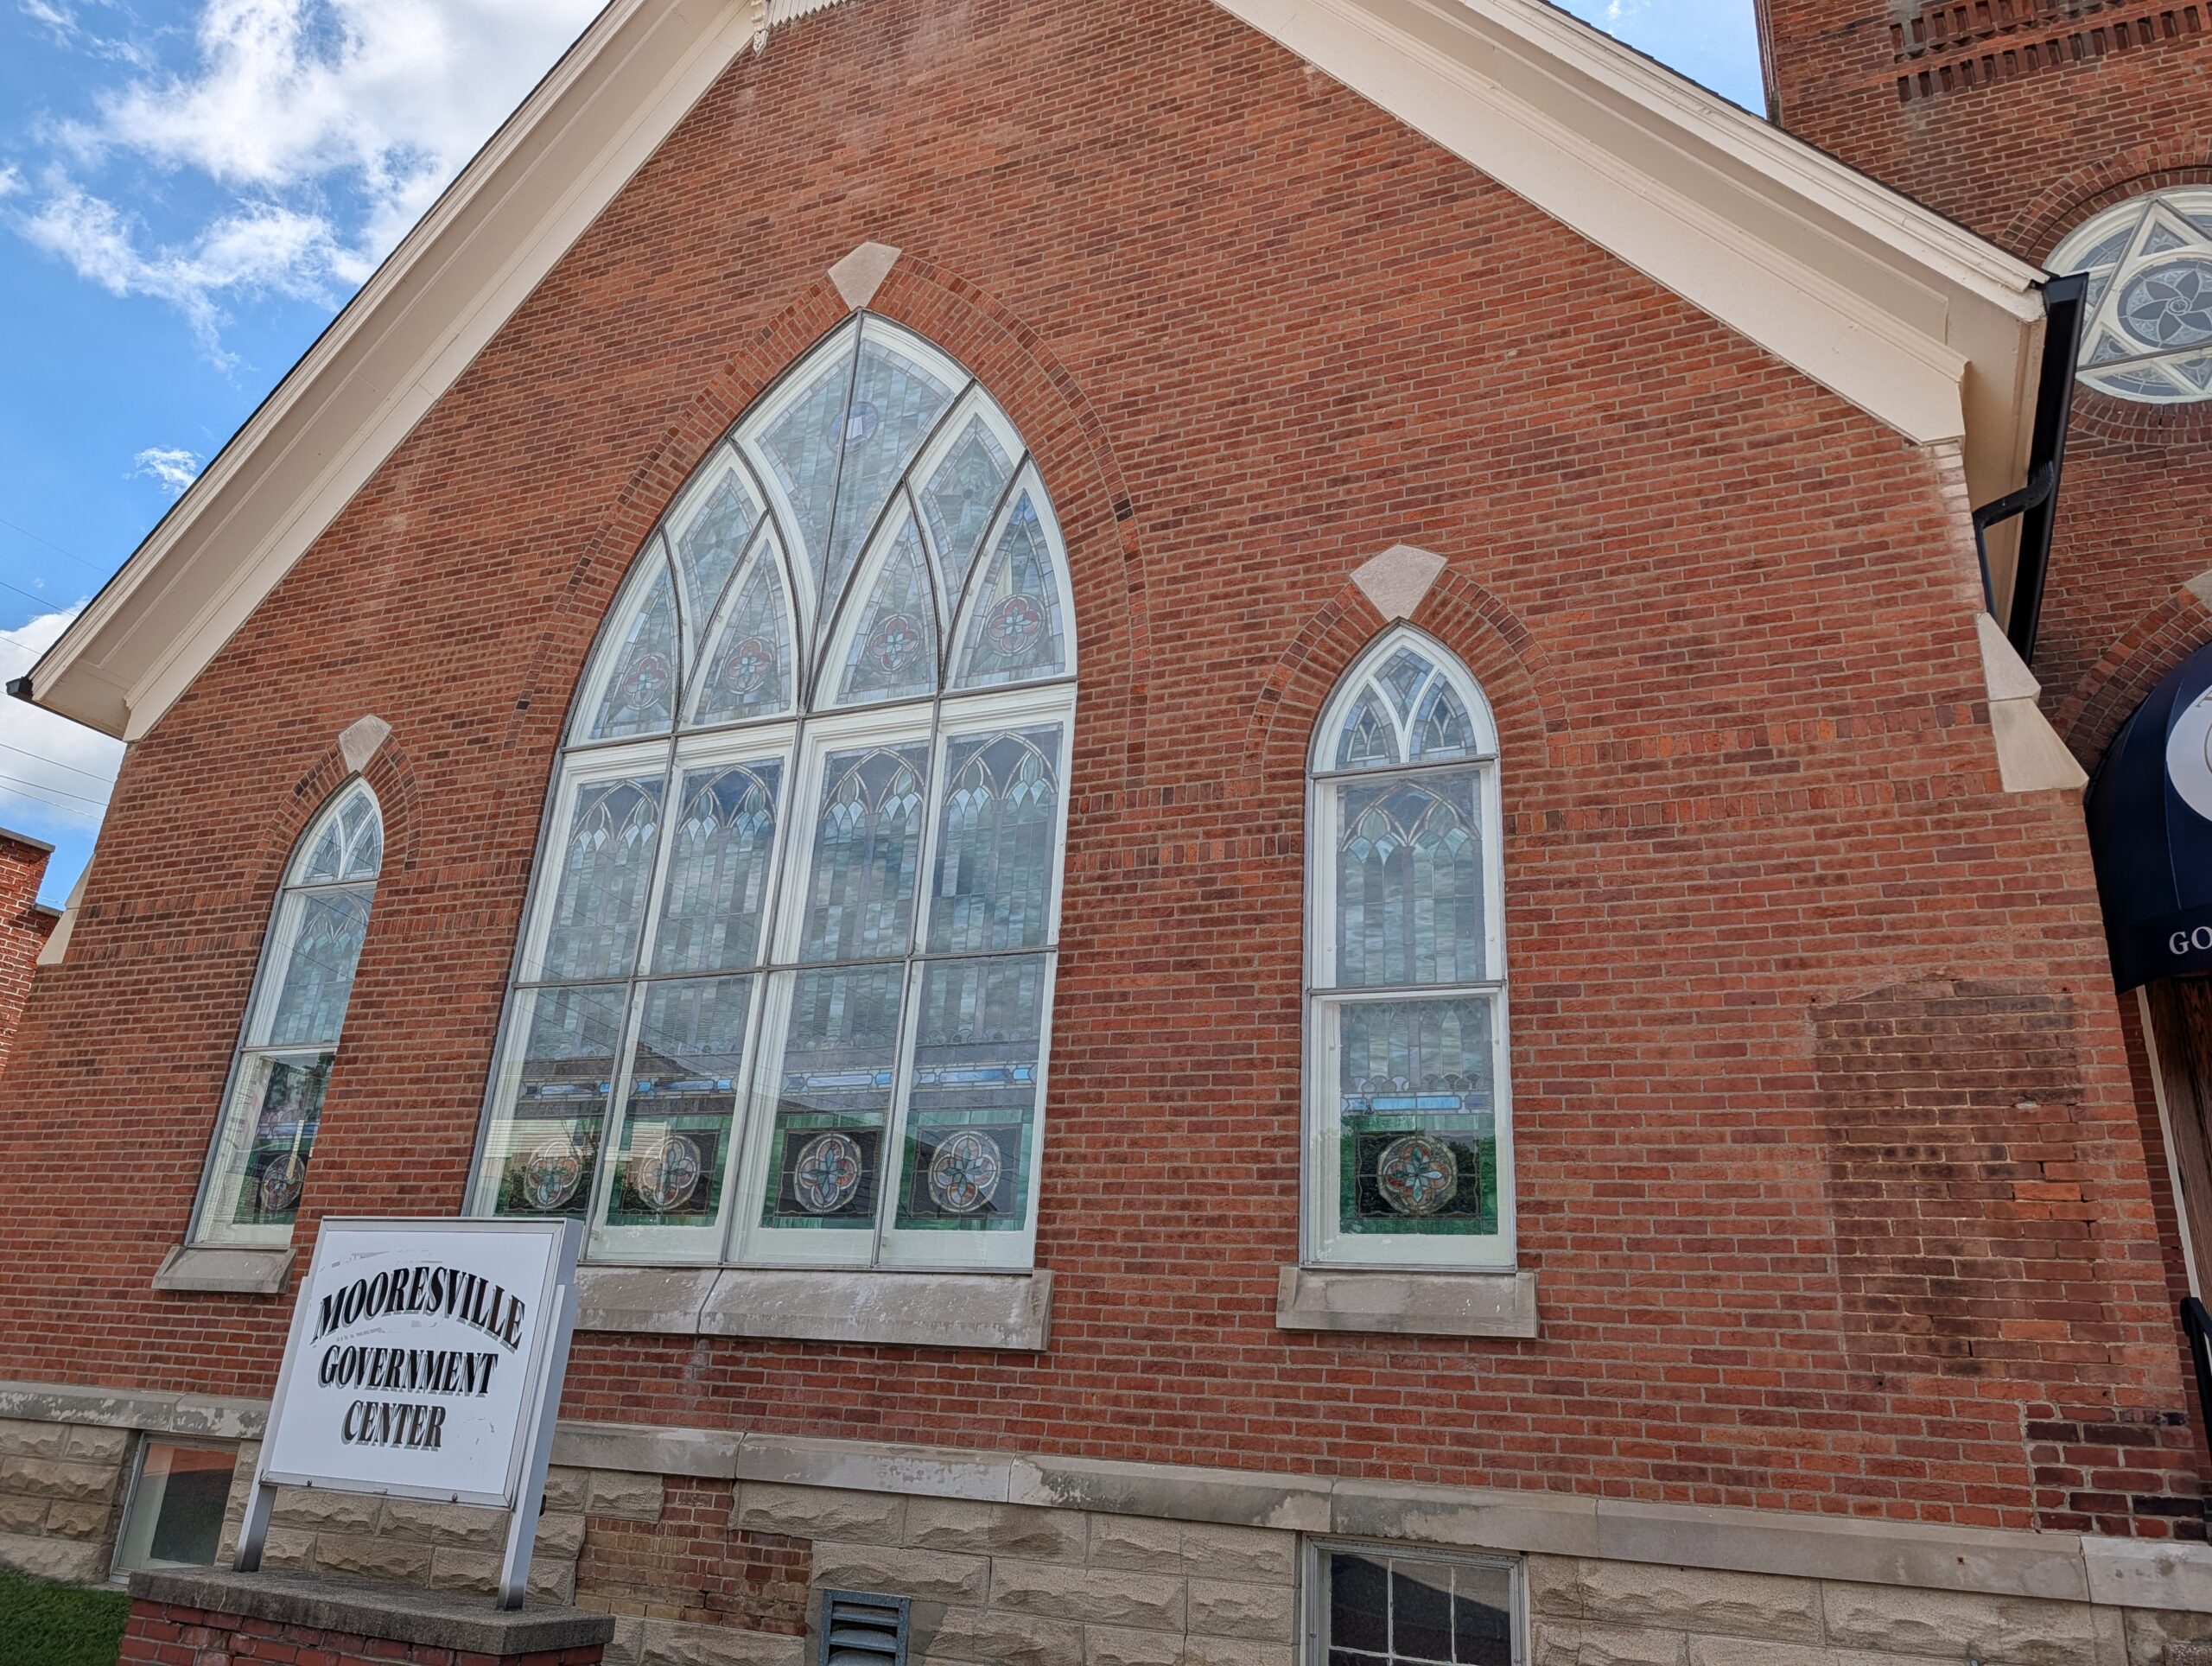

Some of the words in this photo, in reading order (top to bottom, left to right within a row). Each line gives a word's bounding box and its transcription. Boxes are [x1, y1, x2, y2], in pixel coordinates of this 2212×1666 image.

[2169, 925, 2212, 955] GO
[310, 1266, 526, 1351] MOORESVILLE
[319, 1344, 499, 1396] GOVERNMENT
[342, 1399, 447, 1450] CENTER
